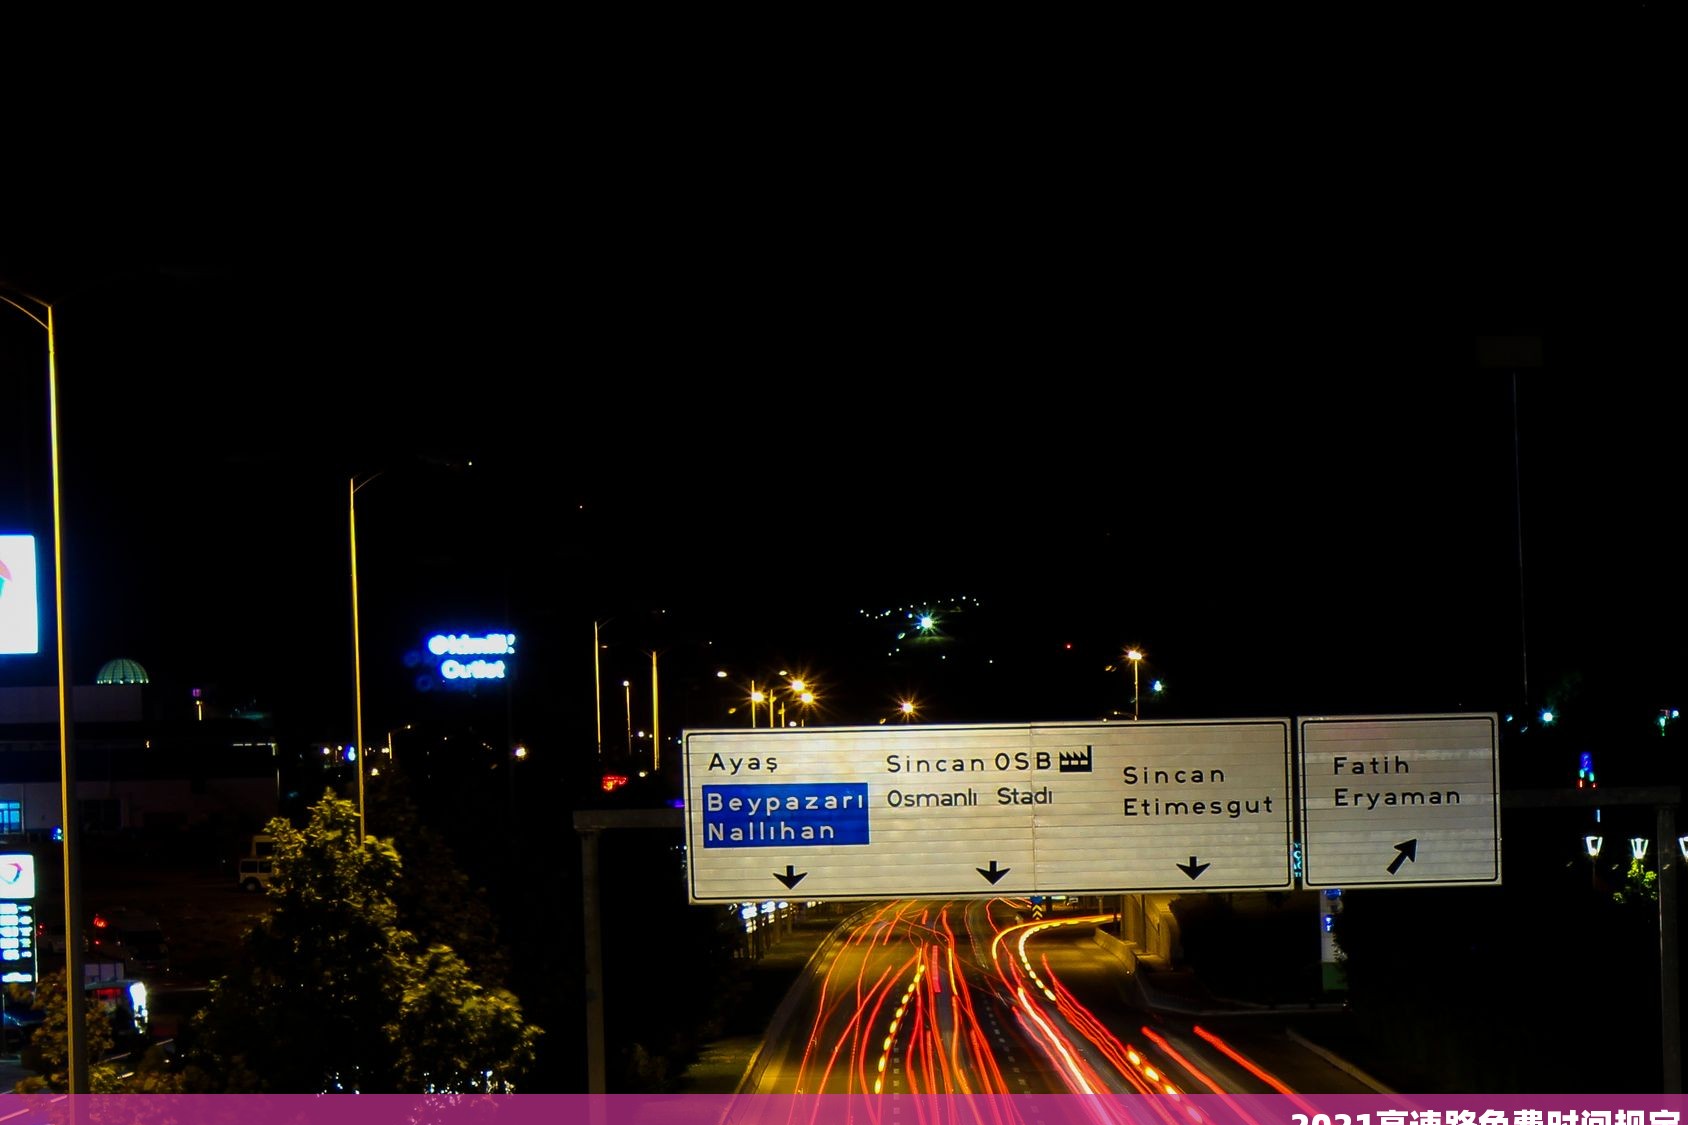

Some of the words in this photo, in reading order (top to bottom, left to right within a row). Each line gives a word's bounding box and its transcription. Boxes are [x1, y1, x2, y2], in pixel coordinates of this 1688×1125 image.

[707, 752, 779, 776] Ayaş
[886, 754, 985, 773] Sincan
[994, 751, 1052, 771] OSB
[1333, 755, 1410, 775] Fatih
[1123, 766, 1225, 785] Sincan
[707, 792, 864, 816] Beypazarı
[886, 788, 978, 808] Osmanlı
[996, 786, 1053, 805] Stadı
[1123, 796, 1273, 819] Etimesgut
[1334, 788, 1461, 811] Eryaman
[707, 821, 835, 842] Nallıhan
